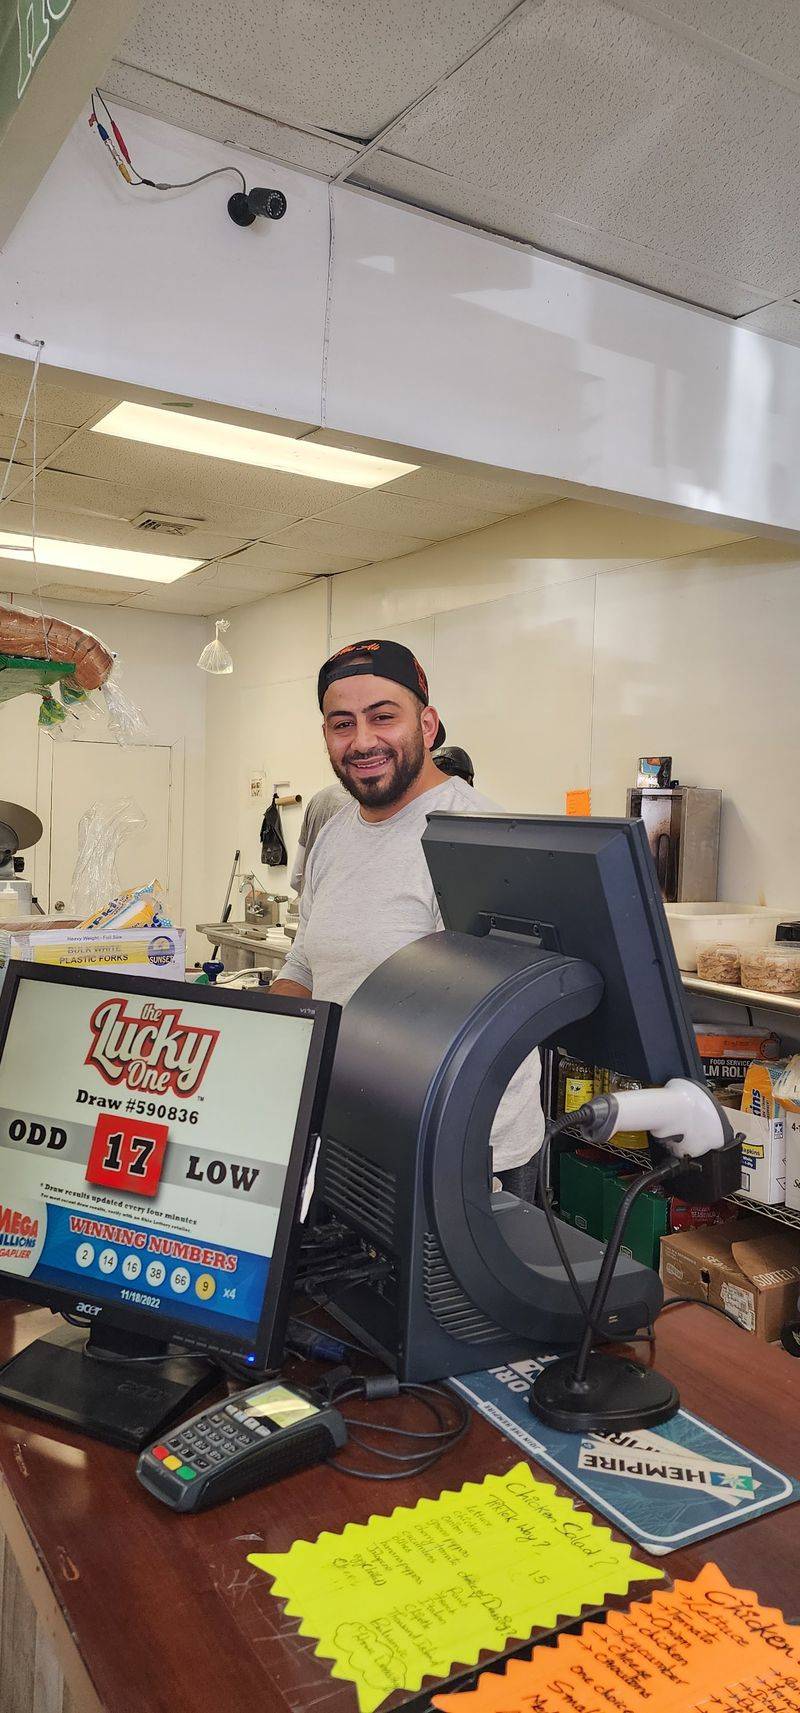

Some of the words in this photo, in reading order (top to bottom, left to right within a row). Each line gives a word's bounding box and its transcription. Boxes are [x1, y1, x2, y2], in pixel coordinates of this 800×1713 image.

[59, 956, 96, 965] PLASTIC
[98, 954, 128, 963] FORKS
[140, 1003, 162, 1022] the
[92, 1003, 213, 1091] Lucky
[127, 1059, 171, 1092] One
[703, 1065, 719, 1076] LM
[75, 1089, 123, 1110] Draw
[126, 1098, 200, 1125] #590836
[8, 1118, 68, 1150] ODD
[102, 1132, 156, 1177] 17
[185, 1155, 260, 1192] LOW
[45, 1183, 64, 1194] Draw
[65, 1186, 90, 1200] results
[92, 1193, 123, 1208] updated
[124, 1202, 145, 1215] every
[146, 1207, 164, 1218] four
[165, 1212, 197, 1225] minutes
[0, 1233, 36, 1248] ILLIONS
[0, 1248, 31, 1259] GAPLIER
[69, 1215, 147, 1250] WINNING
[147, 1234, 239, 1274] NUMBERS
[82, 1249, 89, 1260] 2
[103, 1255, 114, 1267] 14
[126, 1261, 138, 1273] 16
[150, 1267, 162, 1279] 38
[174, 1274, 187, 1286] 66
[202, 1281, 209, 1292] 9
[223, 1288, 237, 1299] x4
[76, 1302, 103, 1316] acer
[120, 1289, 161, 1309] 11/18/2022
[583, 1454, 706, 1484] HEMPIRE
[505, 1482, 557, 1523] Chicken
[553, 1521, 602, 1556] Salad
[527, 1569, 551, 1585] 15
[704, 1590, 793, 1658] Chicken
